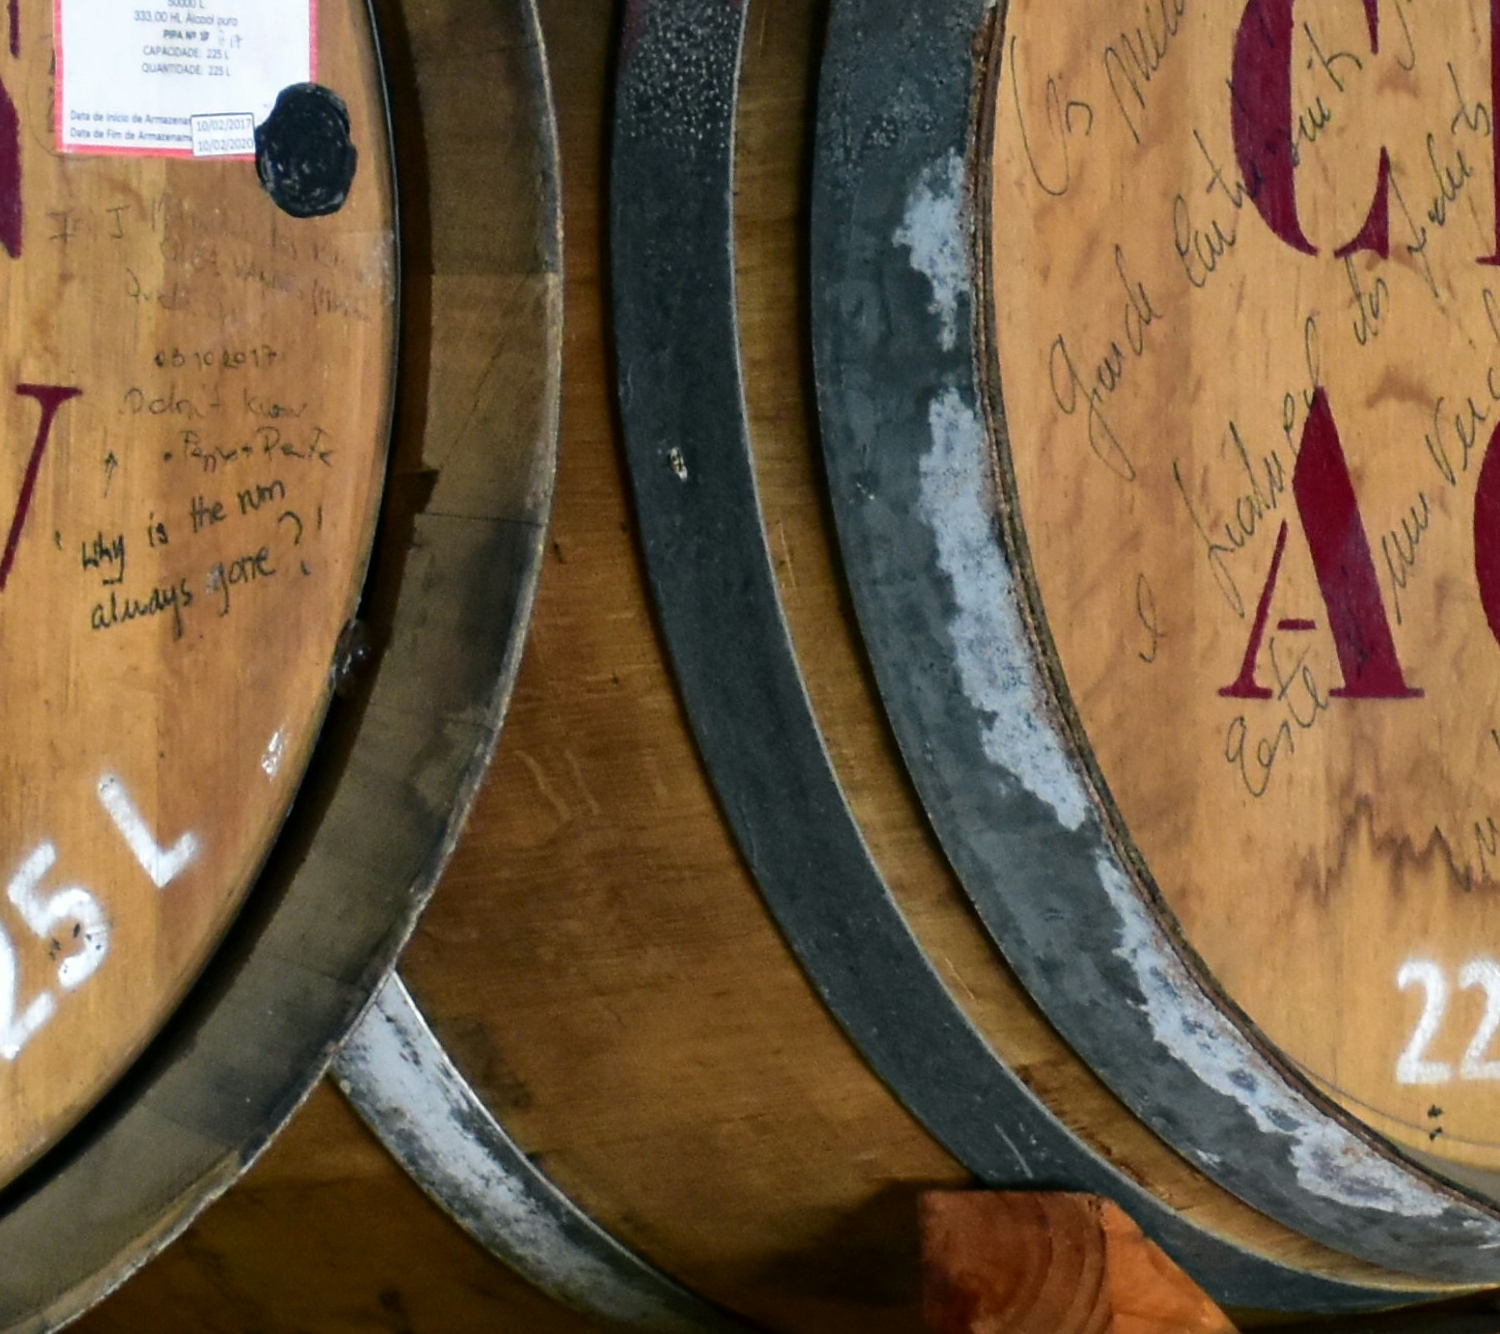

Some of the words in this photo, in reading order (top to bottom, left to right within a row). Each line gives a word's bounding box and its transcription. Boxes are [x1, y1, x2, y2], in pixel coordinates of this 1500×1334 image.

[70, 110, 90, 122] Data
[70, 127, 91, 139] Data
[148, 513, 168, 546] is
[191, 494, 227, 534] the
[238, 480, 285, 513] rum
[90, 576, 193, 641] always
[98, 772, 203, 889] L
